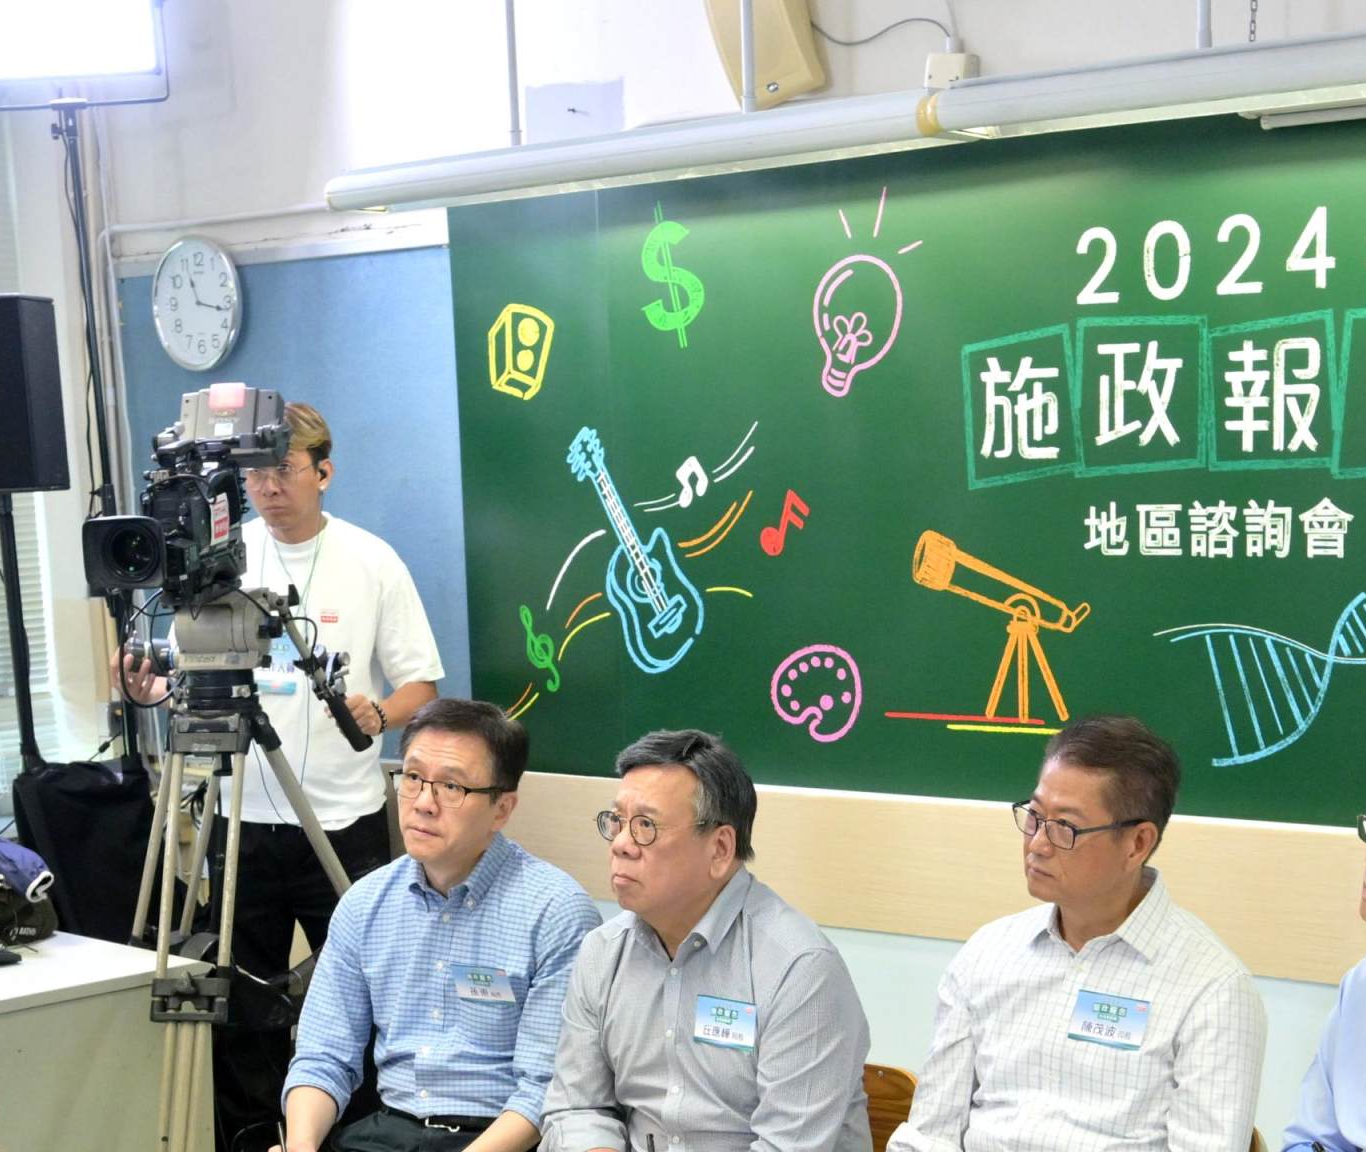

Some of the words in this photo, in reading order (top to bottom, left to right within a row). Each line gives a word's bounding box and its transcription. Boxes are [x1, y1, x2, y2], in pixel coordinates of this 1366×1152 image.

[180, 257, 189, 272] 11
[193, 251, 204, 266] 12
[172, 274, 183, 289] 10
[219, 272, 228, 287] 2
[170, 297, 179, 311] 9
[223, 295, 233, 310] 3
[174, 319, 183, 333] 8
[221, 318, 229, 329] 4
[185, 334, 193, 349] 7
[197, 339, 207, 354] 6
[211, 334, 220, 349] 5
[1084, 497, 1354, 559] 地區諮詢會
